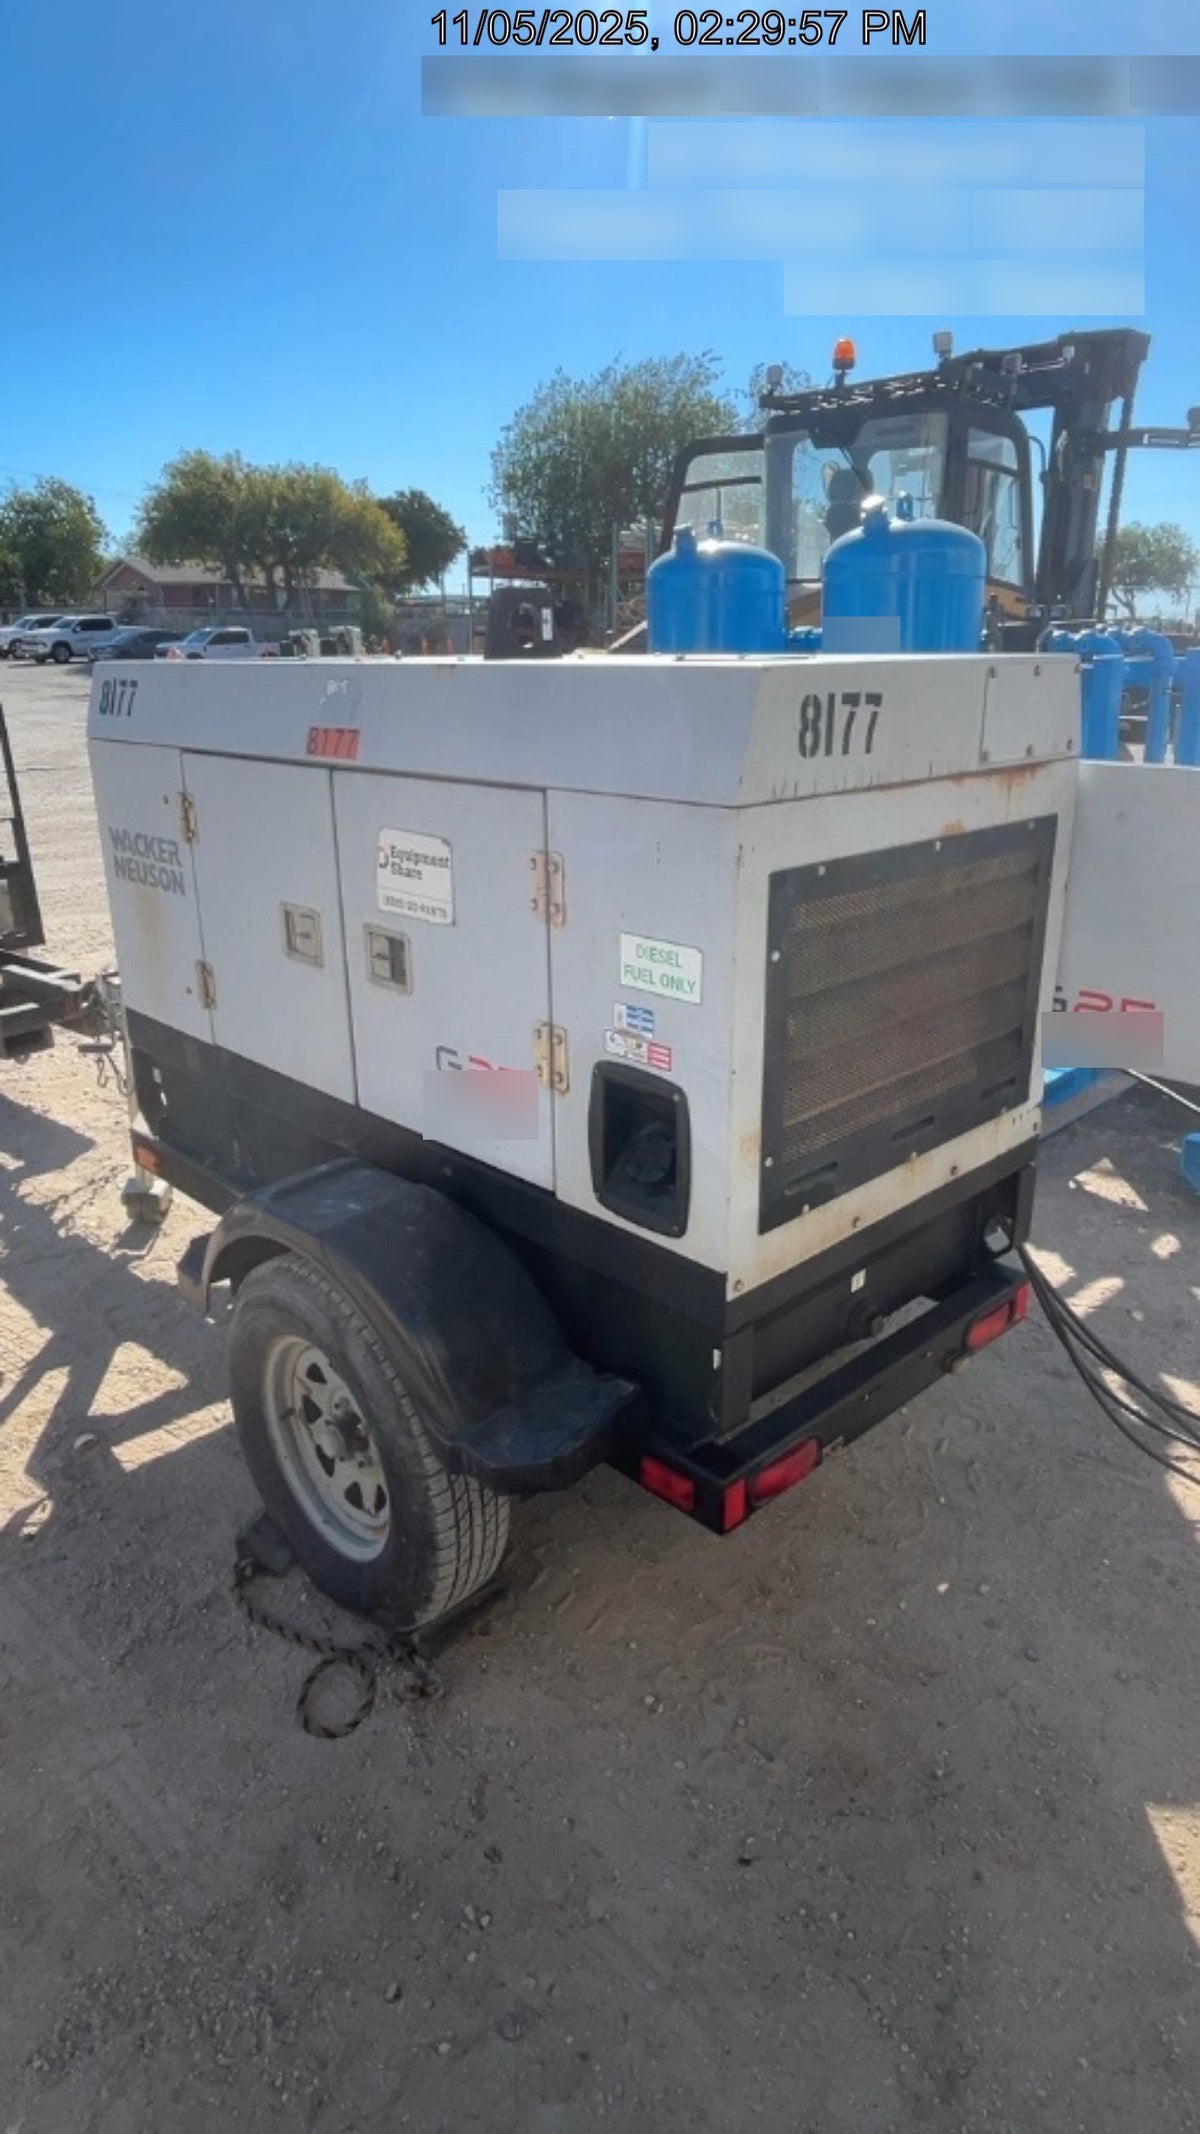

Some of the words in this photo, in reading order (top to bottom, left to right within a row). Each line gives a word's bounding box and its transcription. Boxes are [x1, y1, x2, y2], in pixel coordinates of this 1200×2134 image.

[99, 677, 138, 717] 8177
[307, 727, 360, 759] 8177
[799, 692, 883, 758] 8177
[108, 826, 183, 868] WACKER
[391, 845, 450, 868] Equipment
[113, 855, 185, 896] NEUSON
[635, 944, 682, 968] DIESEL
[623, 964, 656, 985] FUEL
[659, 973, 696, 994] ONLY
